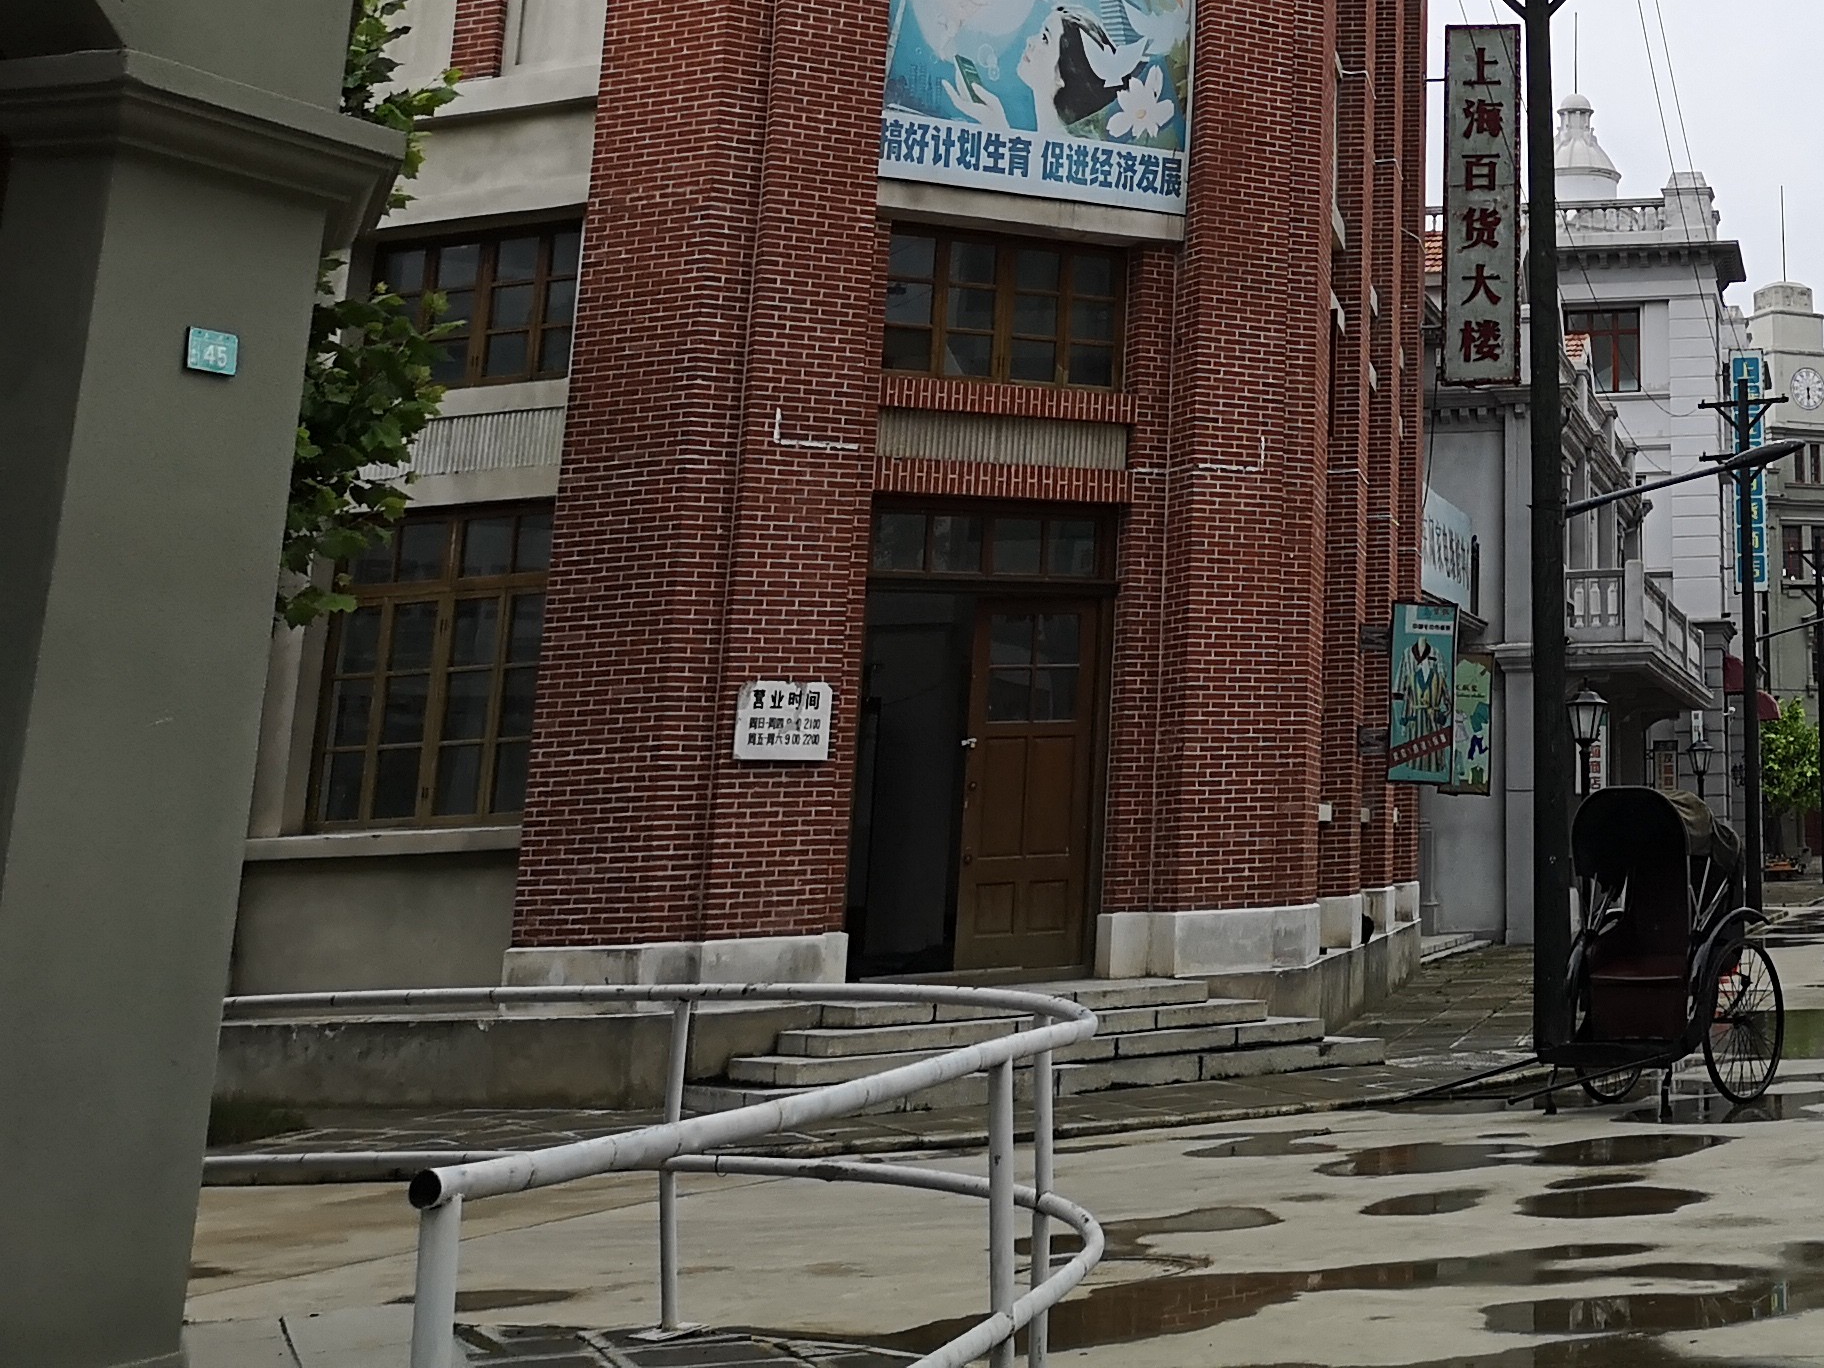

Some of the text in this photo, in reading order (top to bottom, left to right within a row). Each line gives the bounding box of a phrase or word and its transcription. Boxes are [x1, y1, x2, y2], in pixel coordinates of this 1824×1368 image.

[880, 118, 1183, 199] 搞好计划生育 促进经济发展
[1461, 46, 1504, 363] 上海百货大楼
[204, 345, 226, 367] 45
[753, 689, 820, 710] 营业时间
